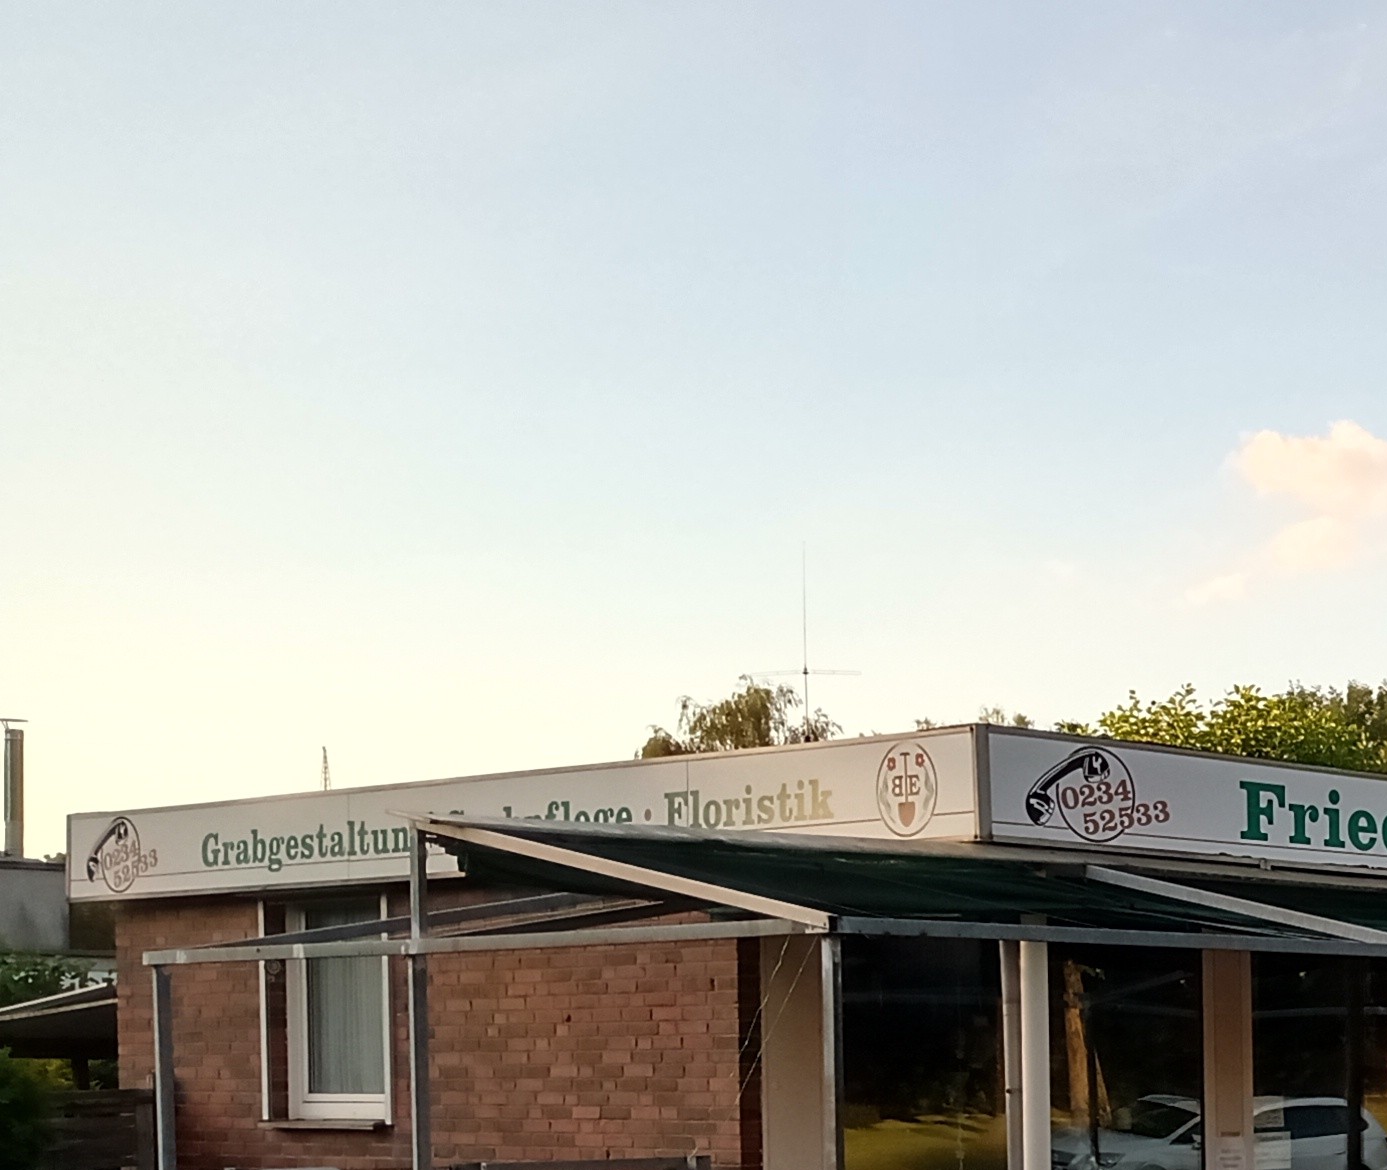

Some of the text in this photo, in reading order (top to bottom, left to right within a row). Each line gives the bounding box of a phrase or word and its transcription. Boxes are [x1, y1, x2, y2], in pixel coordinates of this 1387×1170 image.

[1061, 779, 1132, 810] 0234
[201, 819, 413, 873] Grabgestaltun
[664, 778, 835, 830] Floristik
[1083, 800, 1170, 835] 52533
[104, 839, 140, 871] 0234
[113, 849, 158, 888] 52533
